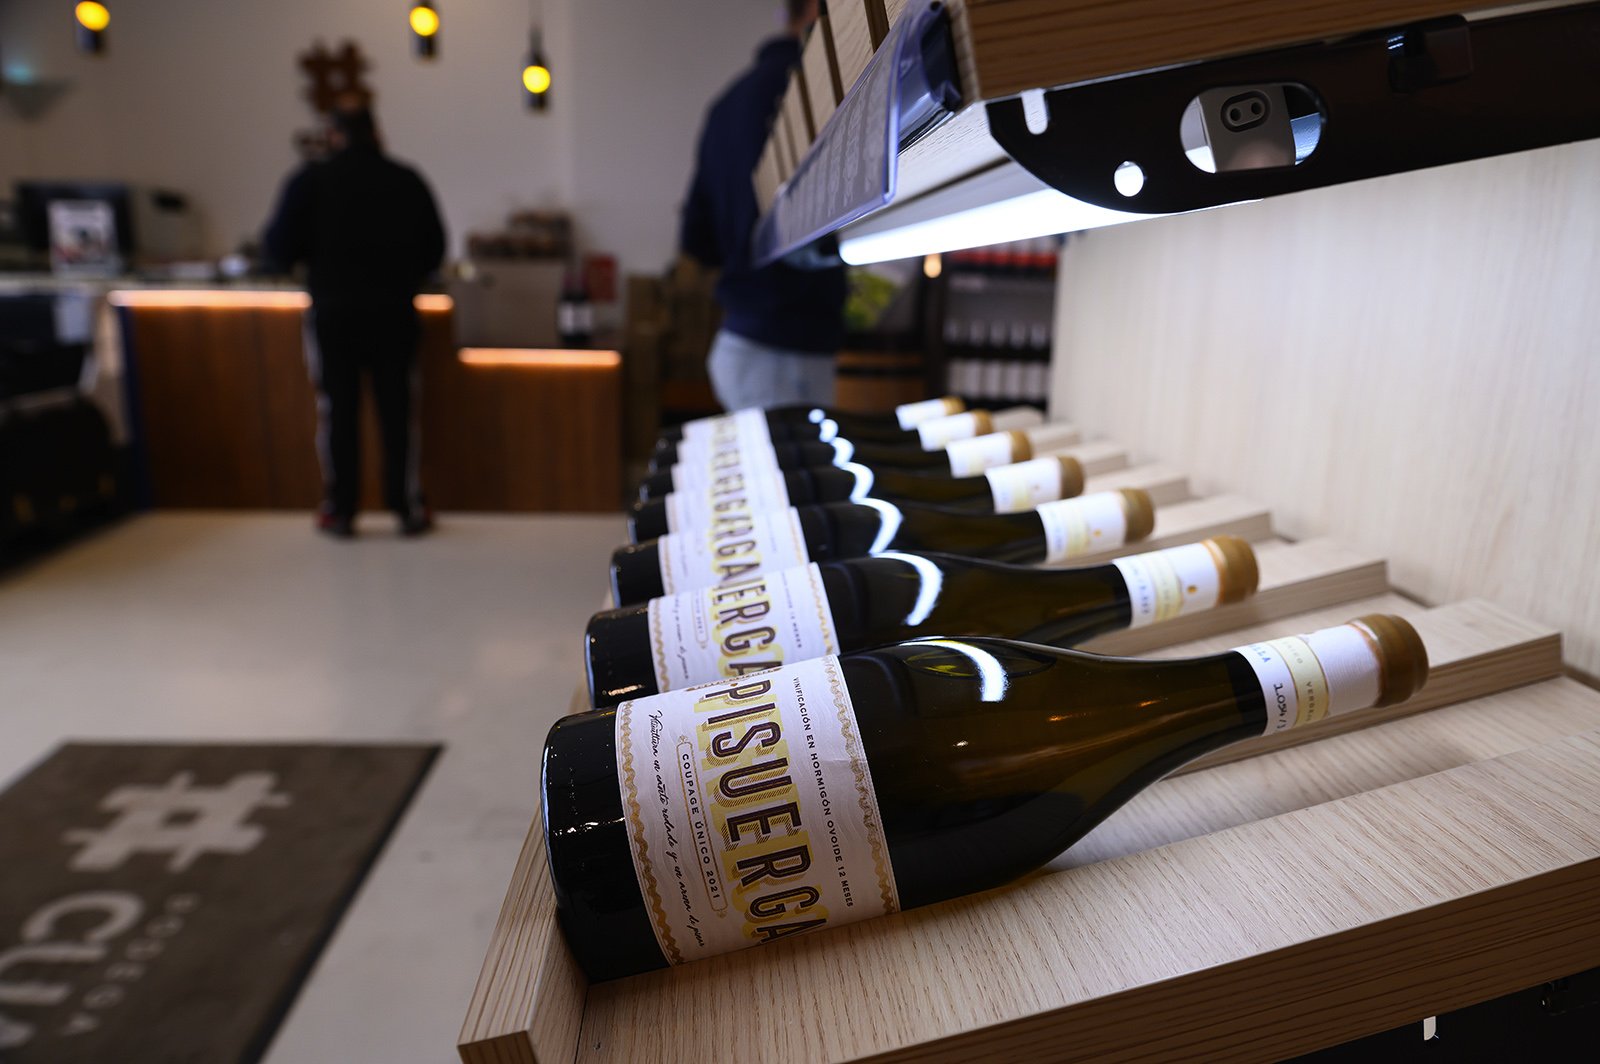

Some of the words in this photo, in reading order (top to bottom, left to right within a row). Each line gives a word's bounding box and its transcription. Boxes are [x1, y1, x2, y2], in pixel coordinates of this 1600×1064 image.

[793, 677, 811, 731] VINIFICACIÓN
[806, 734, 815, 749] EN
[810, 753, 831, 815] HORMIGÓN
[682, 753, 699, 815] COUPAGE
[694, 820, 710, 864] ÚNICO
[706, 870, 720, 899] 2021
[703, 679, 828, 944] PISUERGA
[827, 820, 843, 862] OVOIDE
[666, 850, 677, 863] y
[679, 881, 692, 912] arena
[689, 915, 699, 926] de
[838, 866, 846, 877] 12
[841, 880, 853, 907] MESES
